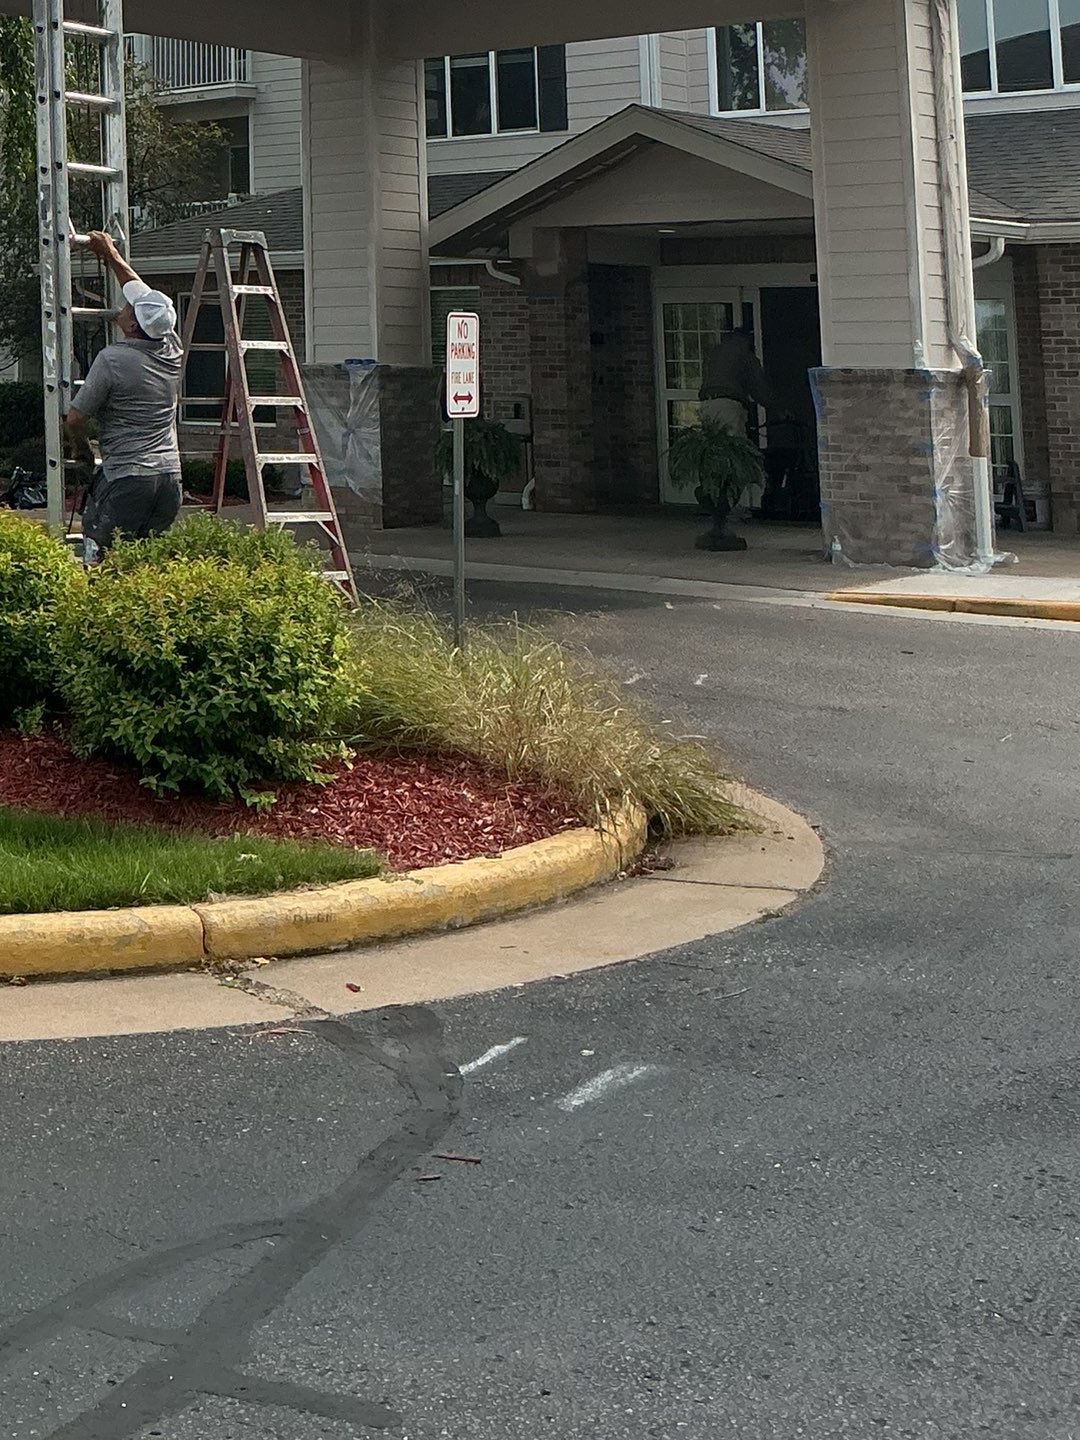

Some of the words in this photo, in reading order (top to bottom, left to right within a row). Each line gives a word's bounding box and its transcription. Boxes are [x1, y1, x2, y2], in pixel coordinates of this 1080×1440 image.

[457, 322, 468, 339] NO
[451, 343, 475, 359] PARKING
[451, 372, 461, 384] FIRE
[463, 372, 475, 384] LANE
